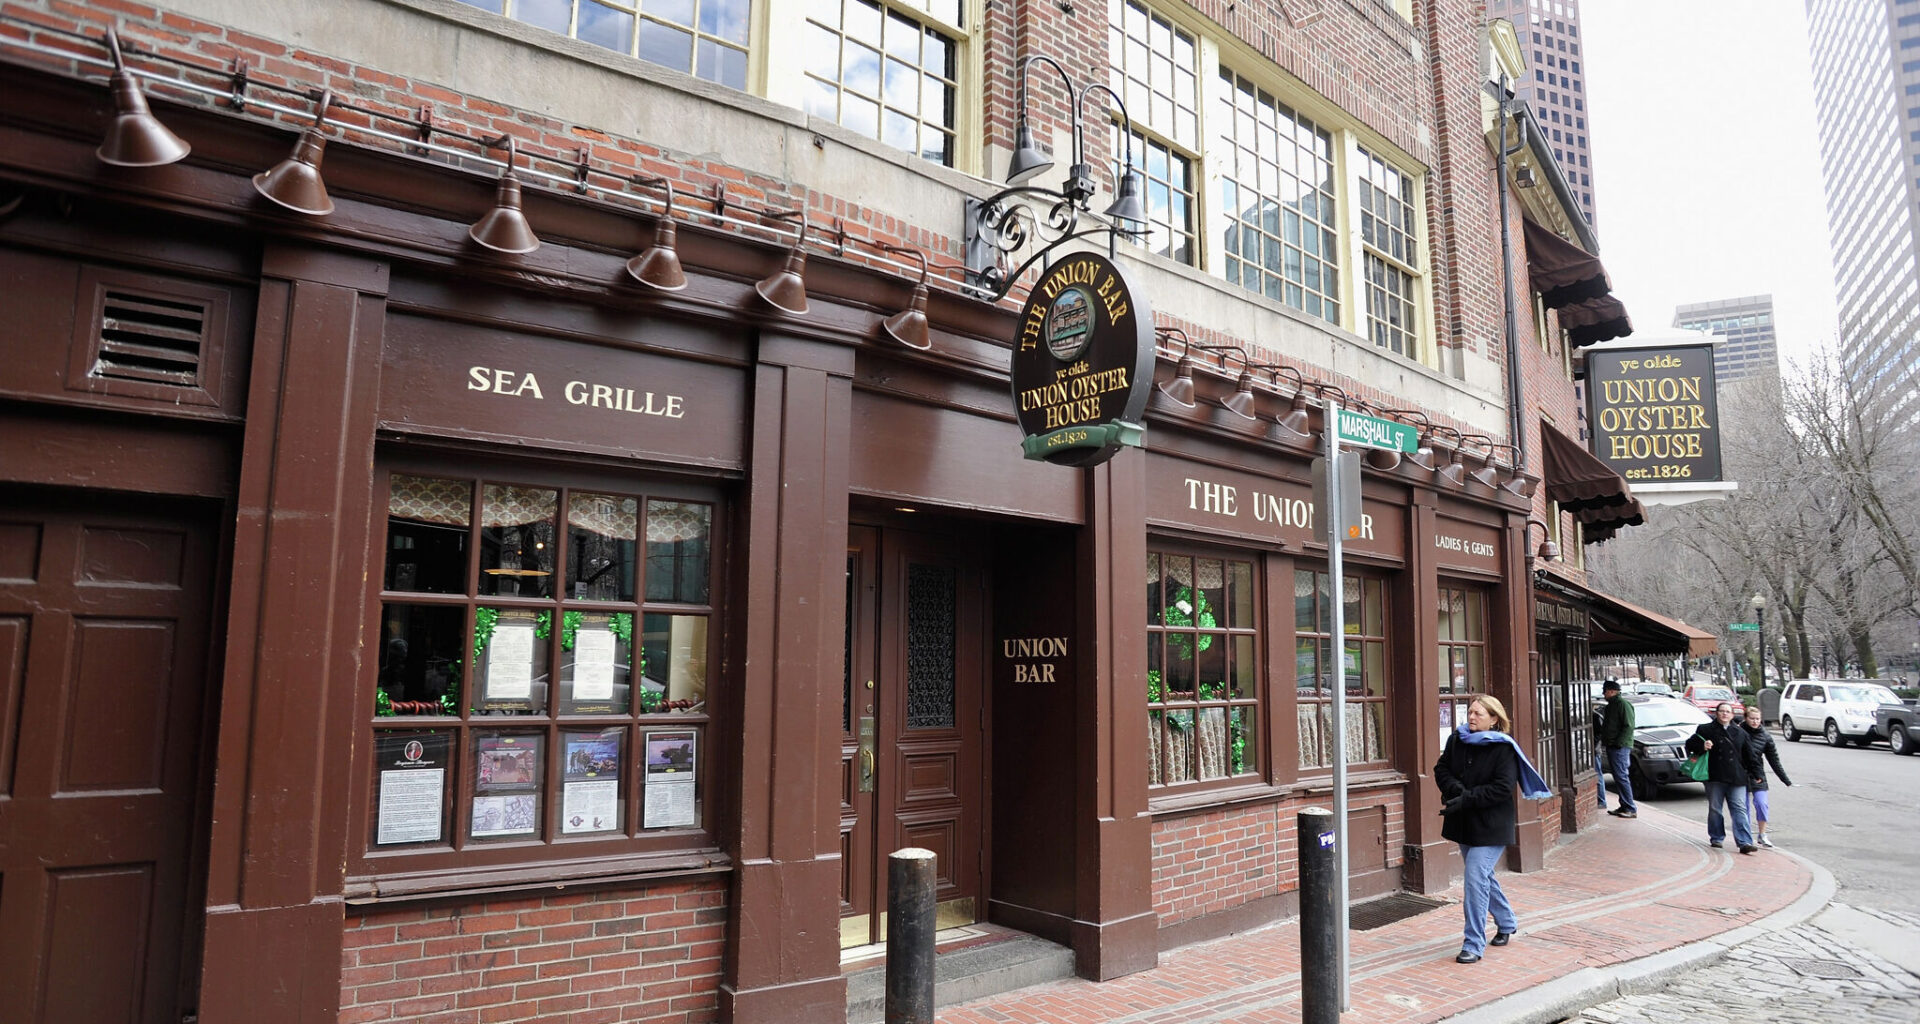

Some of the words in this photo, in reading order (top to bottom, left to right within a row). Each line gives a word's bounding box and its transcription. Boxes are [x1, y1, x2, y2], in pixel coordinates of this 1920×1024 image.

[1021, 303, 1047, 351] THE
[1042, 260, 1101, 299] UNION
[1097, 274, 1128, 326] BAR
[1055, 367, 1067, 383] ye
[1068, 361, 1090, 376] olde
[1620, 359, 1639, 374] ye
[1643, 354, 1682, 369] olde
[468, 366, 544, 400] SEA
[564, 380, 685, 419] GRILLE
[1021, 381, 1069, 412] UNION
[1071, 367, 1129, 398] OYSTER
[1602, 376, 1701, 404] UNION
[1045, 395, 1101, 429] HOUSE
[1600, 404, 1711, 432] OYSTER
[1341, 414, 1393, 445] MARSHALL
[1394, 431, 1405, 448] ST
[1609, 433, 1703, 459] HOUSE
[1184, 478, 1238, 517] THE
[1435, 534, 1462, 551] LADIES
[1463, 540, 1470, 555] &
[1471, 541, 1494, 557] GENTS
[1003, 637, 1068, 658] UNION
[1014, 663, 1056, 683] BAR
